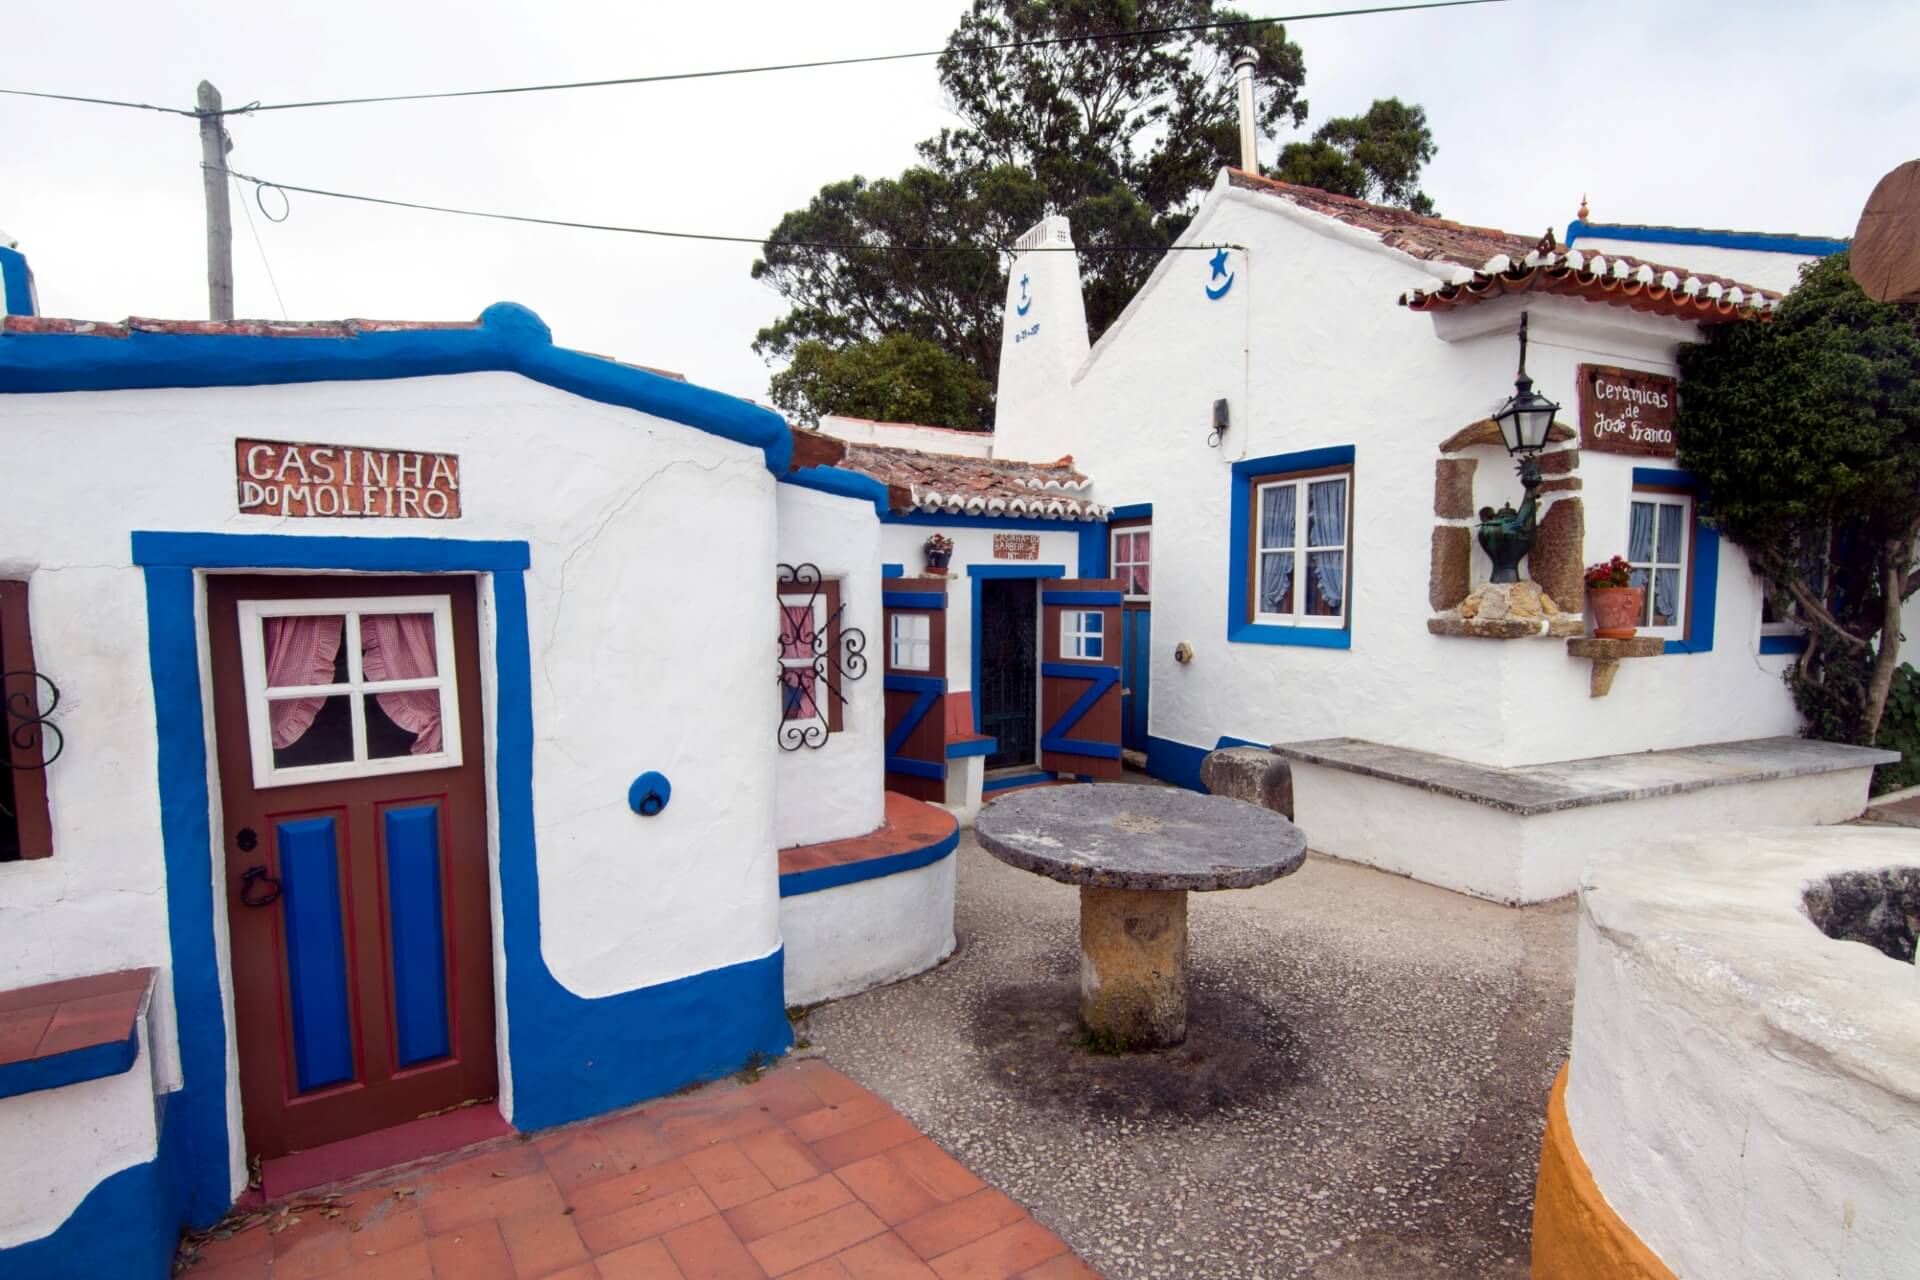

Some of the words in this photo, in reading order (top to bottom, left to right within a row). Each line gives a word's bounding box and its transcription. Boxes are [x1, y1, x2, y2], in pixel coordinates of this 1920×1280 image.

[1595, 379, 1669, 409] Ceramicas
[1625, 403, 1640, 418] de
[1628, 421, 1672, 444] Franco
[246, 444, 458, 490] CASINHA
[280, 483, 449, 518] MOLEIRO
